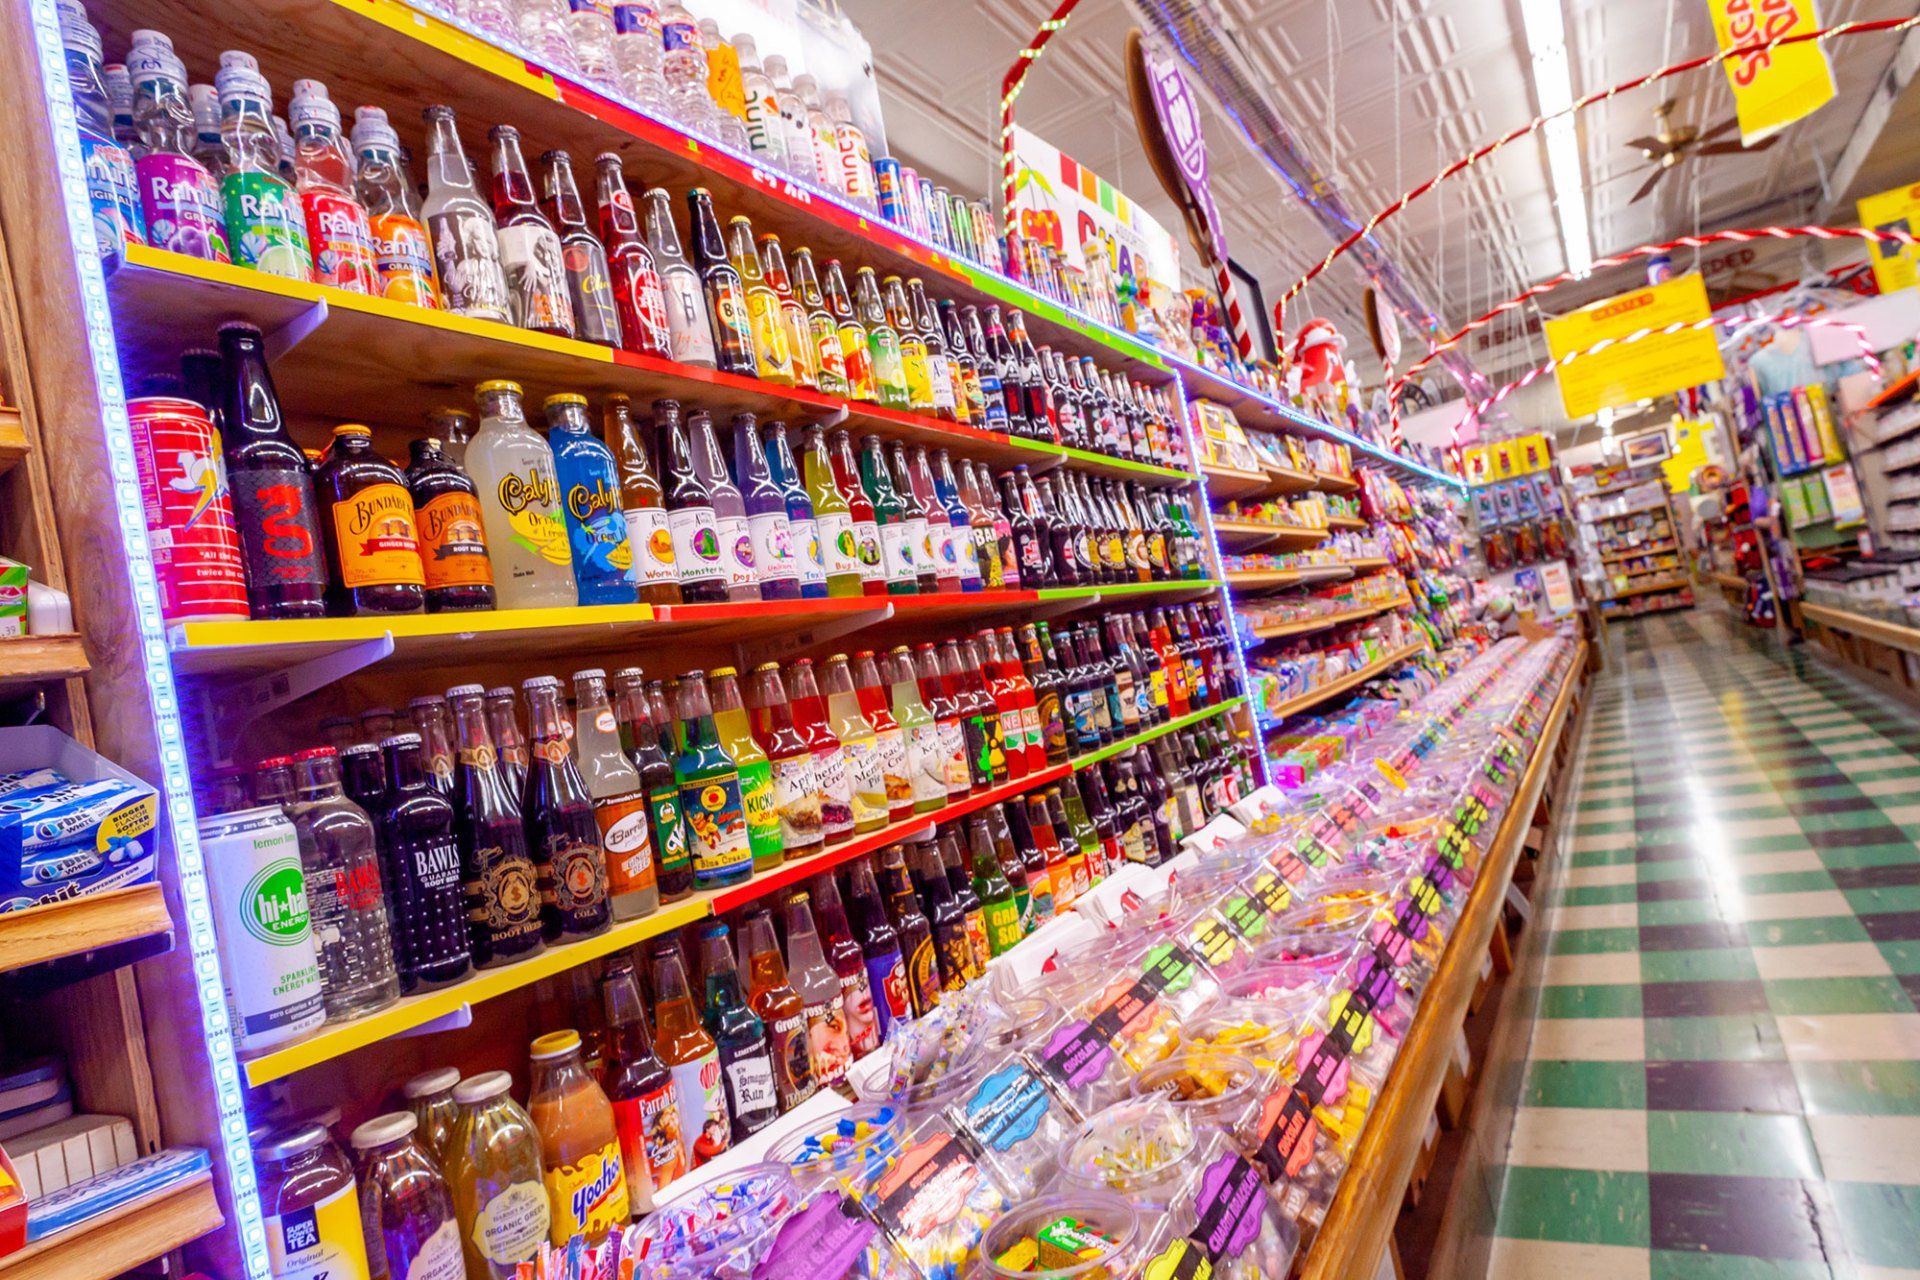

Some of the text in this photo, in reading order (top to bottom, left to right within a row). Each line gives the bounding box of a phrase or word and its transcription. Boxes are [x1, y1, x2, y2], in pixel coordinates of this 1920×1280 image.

[733, 573, 751, 583] Dog
[113, 804, 146, 823] BIGGER
[115, 809, 148, 828] FLAVOR
[66, 818, 95, 834] WHITE
[116, 815, 150, 834] SOFTER
[125, 822, 151, 837] CHEW
[253, 835, 284, 849] lemon
[65, 859, 94, 875] WHITE
[414, 843, 461, 877] BAWLS
[85, 872, 124, 895] PEPPERMINT
[424, 877, 445, 888] ROOT
[574, 908, 599, 920] COLA
[491, 929, 522, 943] ROOT
[804, 1004, 824, 1018] ross
[286, 1219, 313, 1234] SUPER
[287, 1226, 315, 1241] POWER
[485, 1216, 523, 1239] ORGANIC
[288, 1233, 317, 1251] TEA
[286, 1249, 324, 1269] Original
